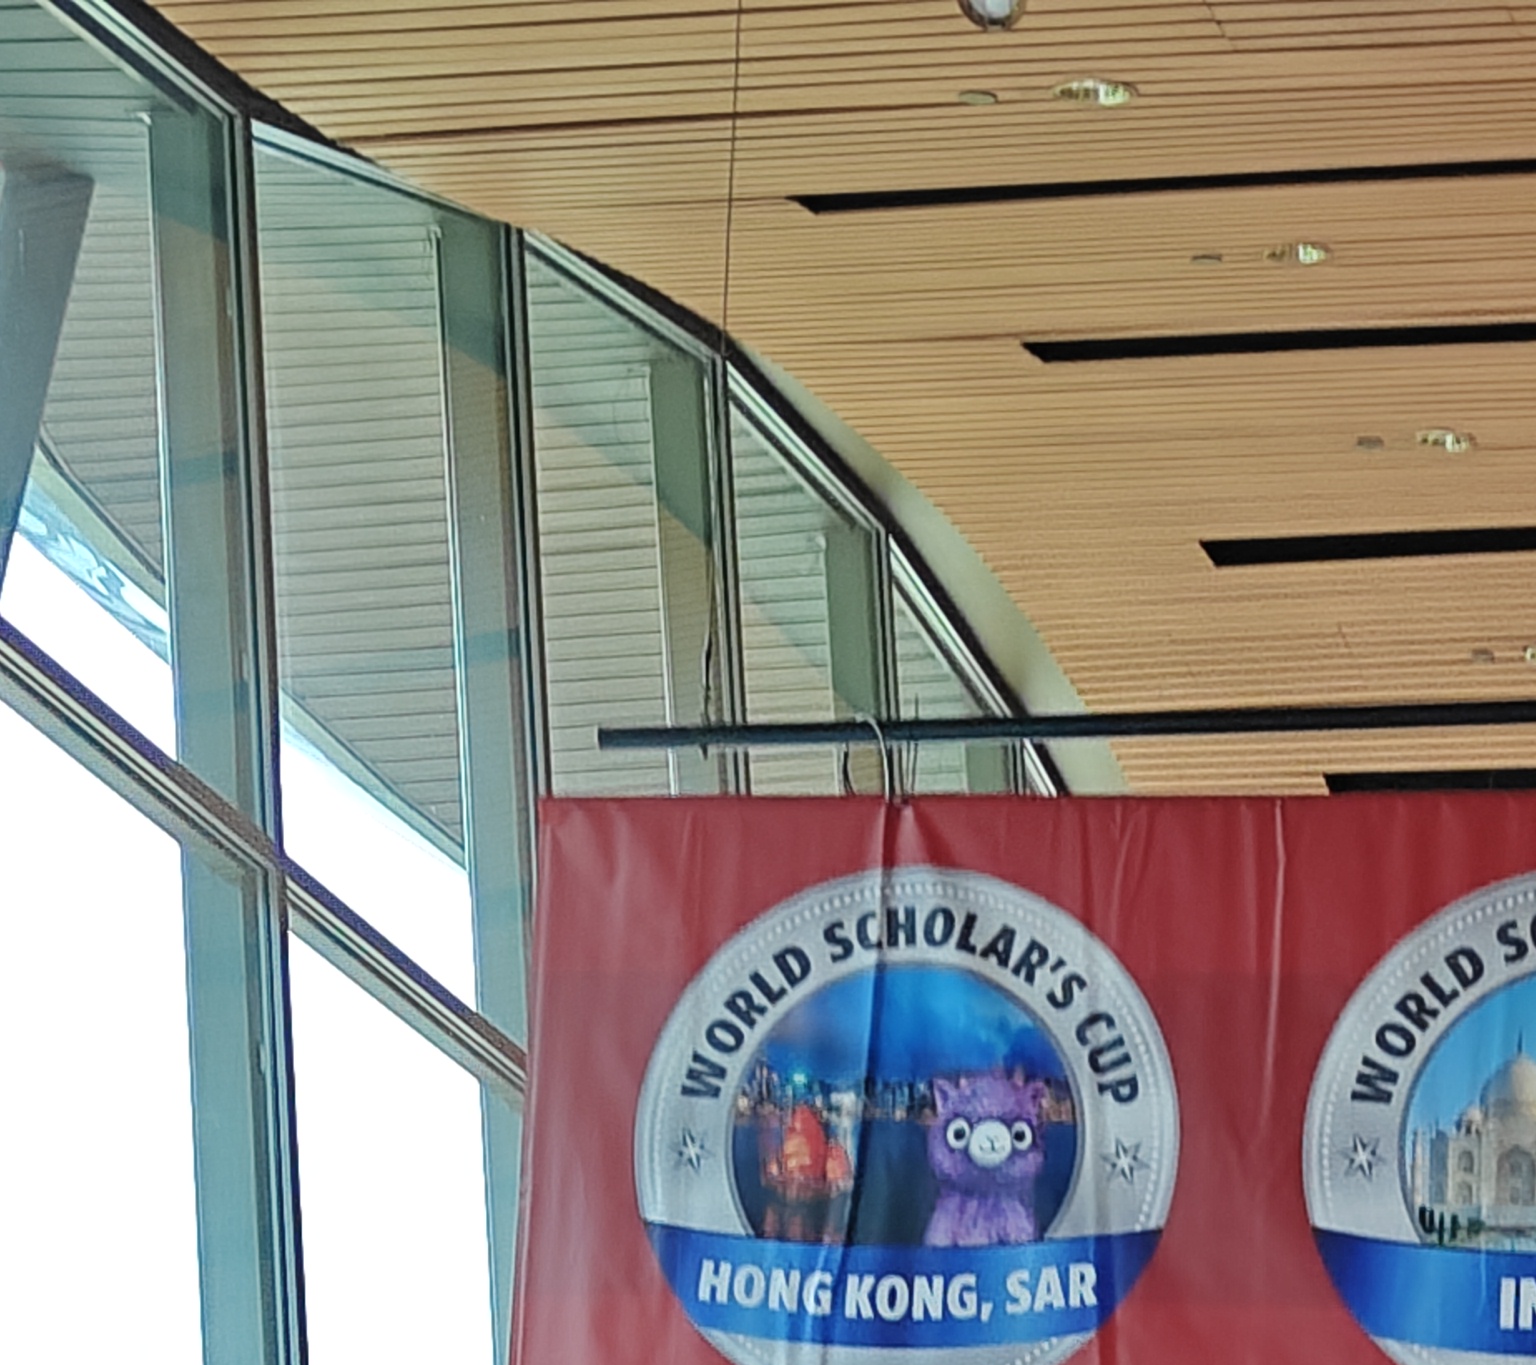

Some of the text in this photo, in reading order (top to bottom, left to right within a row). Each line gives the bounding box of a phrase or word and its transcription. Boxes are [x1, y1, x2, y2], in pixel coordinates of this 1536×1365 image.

[680, 906, 1141, 1106] WORLD SCHOLAR'S CUP
[1350, 945, 1487, 1106] WORLD
[698, 1257, 1098, 1323] HONG KONG, SAR
